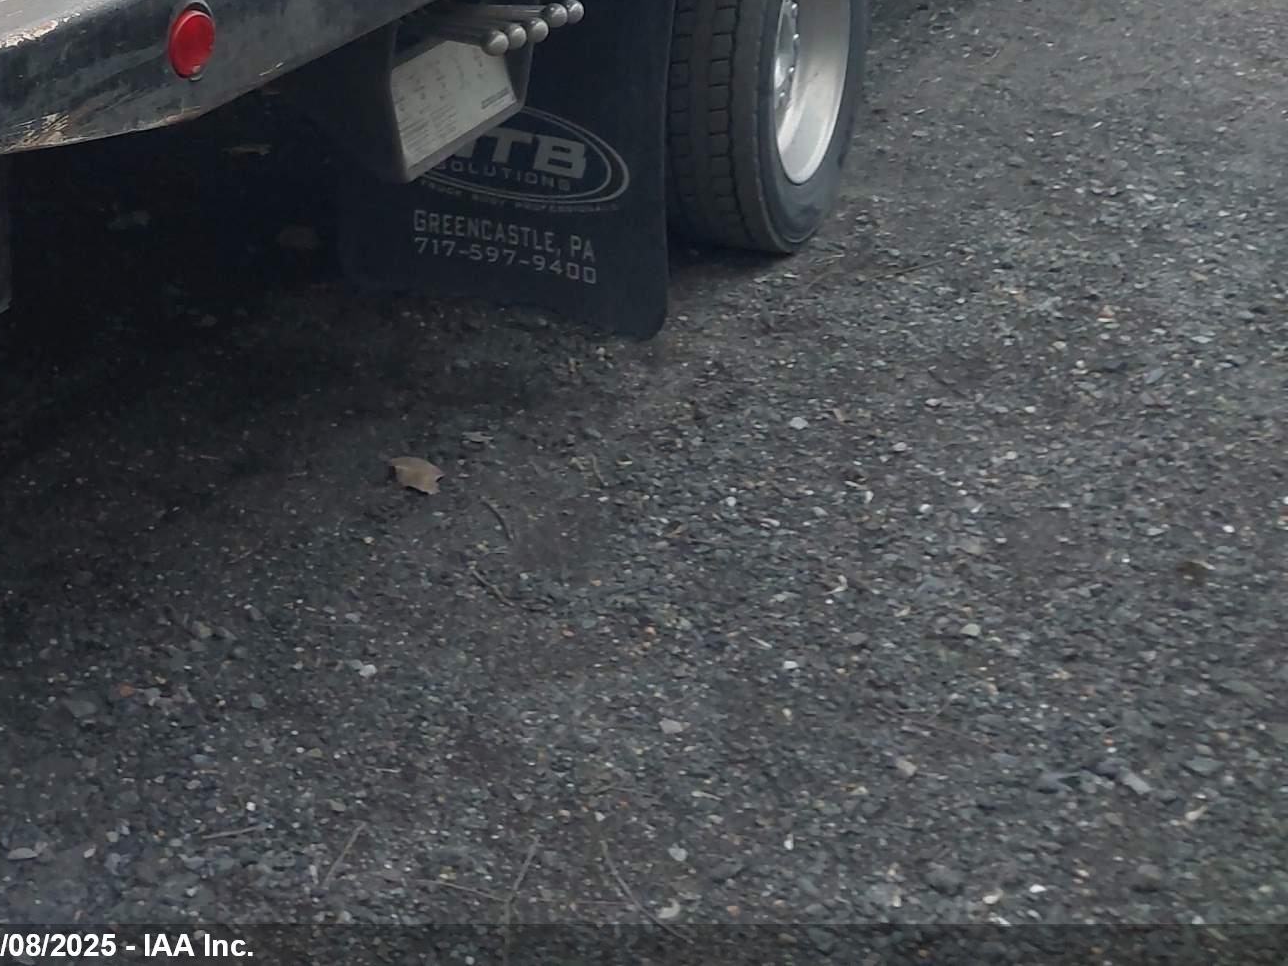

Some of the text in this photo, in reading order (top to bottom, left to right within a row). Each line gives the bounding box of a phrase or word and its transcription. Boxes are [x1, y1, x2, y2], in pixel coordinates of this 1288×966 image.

[413, 209, 596, 263] GREENCASTLE, PA
[414, 237, 597, 284] 717-597-9400
